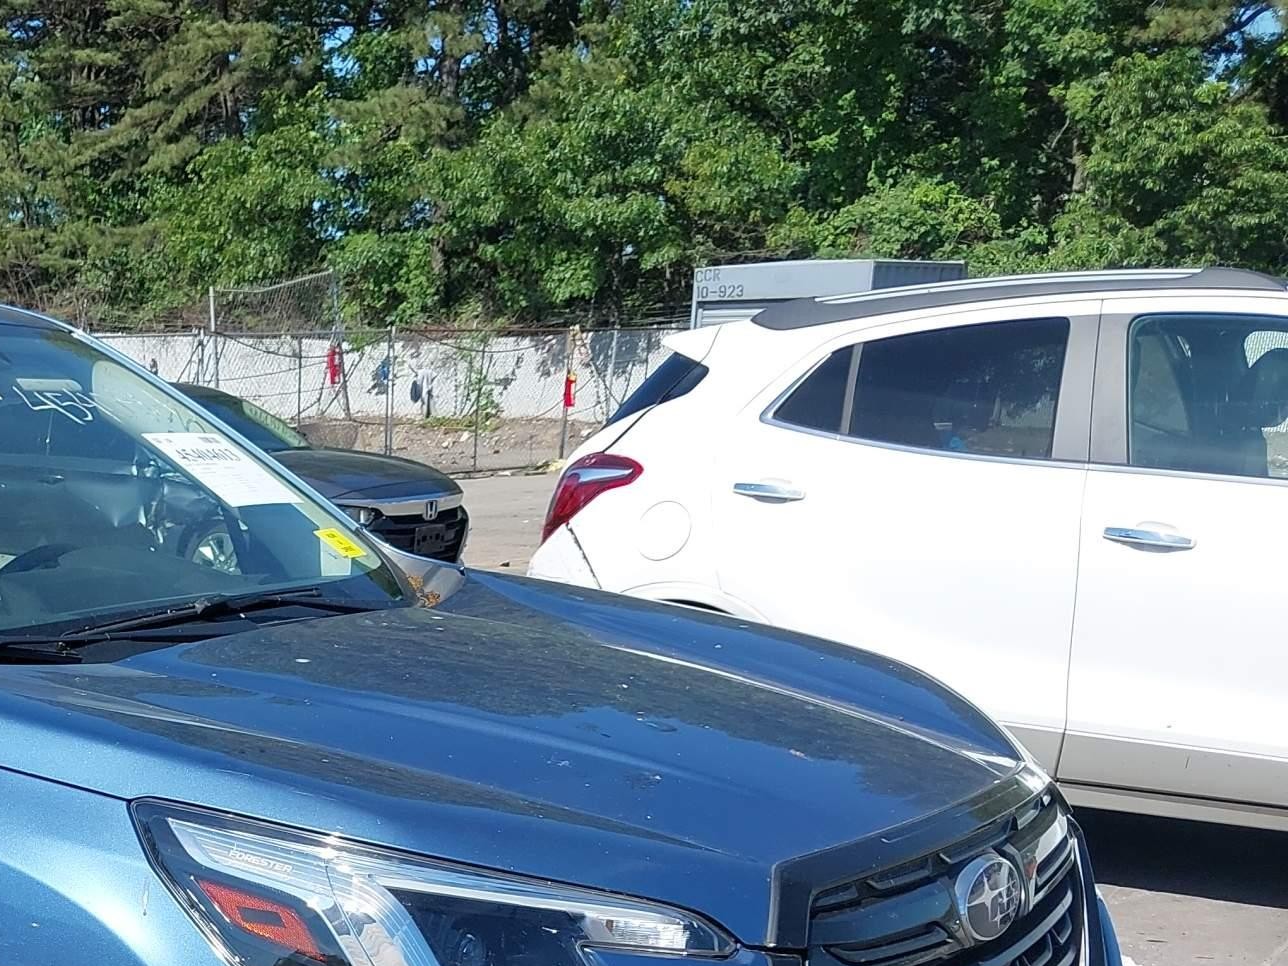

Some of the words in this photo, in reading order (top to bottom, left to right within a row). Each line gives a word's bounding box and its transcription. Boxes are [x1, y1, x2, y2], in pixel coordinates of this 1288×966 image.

[696, 268, 721, 283] CCR
[696, 284, 744, 299] 10-923
[228, 848, 293, 874] FORESTER
